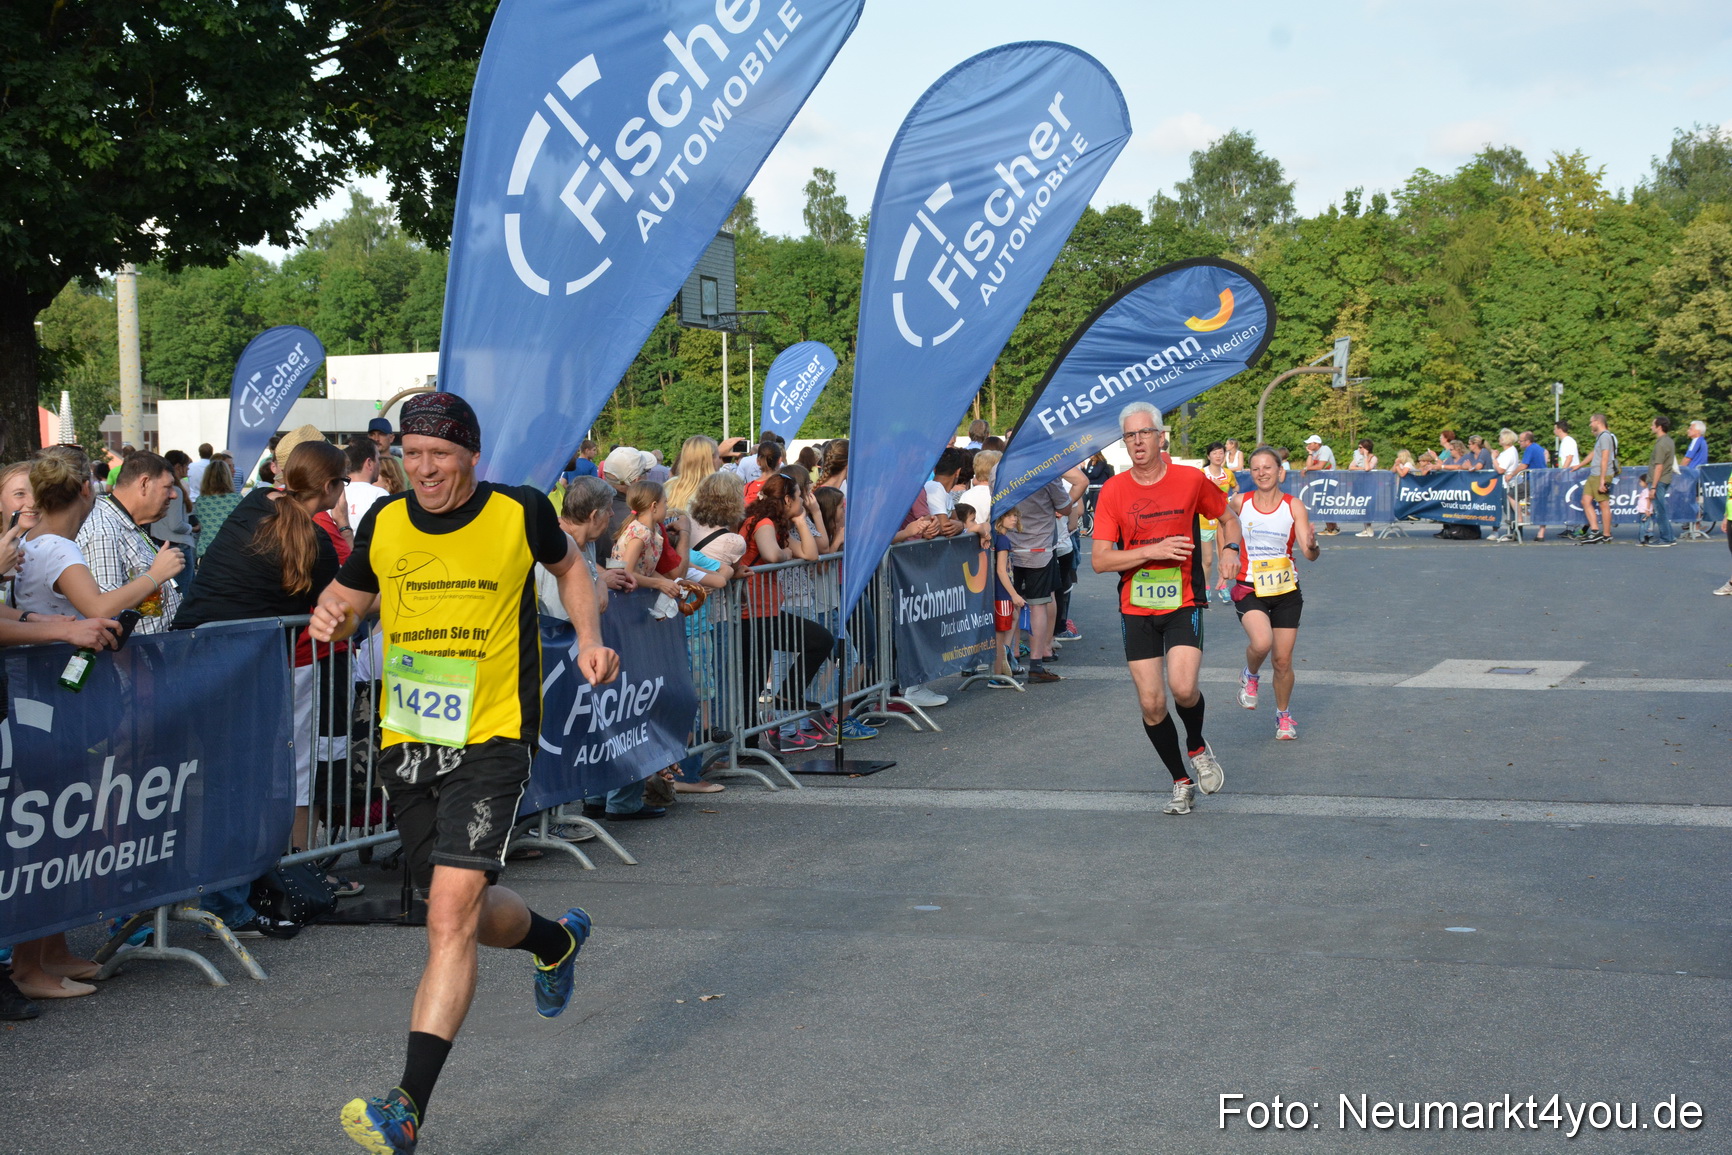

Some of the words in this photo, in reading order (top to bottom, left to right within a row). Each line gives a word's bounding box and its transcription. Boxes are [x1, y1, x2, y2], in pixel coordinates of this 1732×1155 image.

[636, 0, 803, 244] AUTOMOBILE
[927, 91, 1071, 310] Fischer
[979, 132, 1088, 306] AUTOMOBILE
[251, 342, 304, 415] Fischer
[1144, 366, 1184, 393] Druck
[1184, 352, 1212, 370] und
[1210, 325, 1259, 358] Medien
[269, 355, 310, 414] AUTOMOBILE
[780, 354, 821, 414] Fischer
[794, 365, 825, 413] AUTOMOBILE
[1037, 336, 1202, 435] Frischmann
[1311, 491, 1372, 507] Fischer
[1317, 508, 1366, 516] AUTOMOBILE
[1400, 487, 1471, 502] Frischmann
[1459, 502, 1472, 510] und
[406, 578, 476, 591] Physiotherapie
[478, 579, 499, 592] Wild
[1136, 584, 1177, 599] 1109
[1258, 570, 1291, 587] 1112
[390, 632, 401, 644] Wir
[402, 627, 448, 642] machen
[450, 626, 470, 639] Sie
[393, 683, 462, 722] 1428
